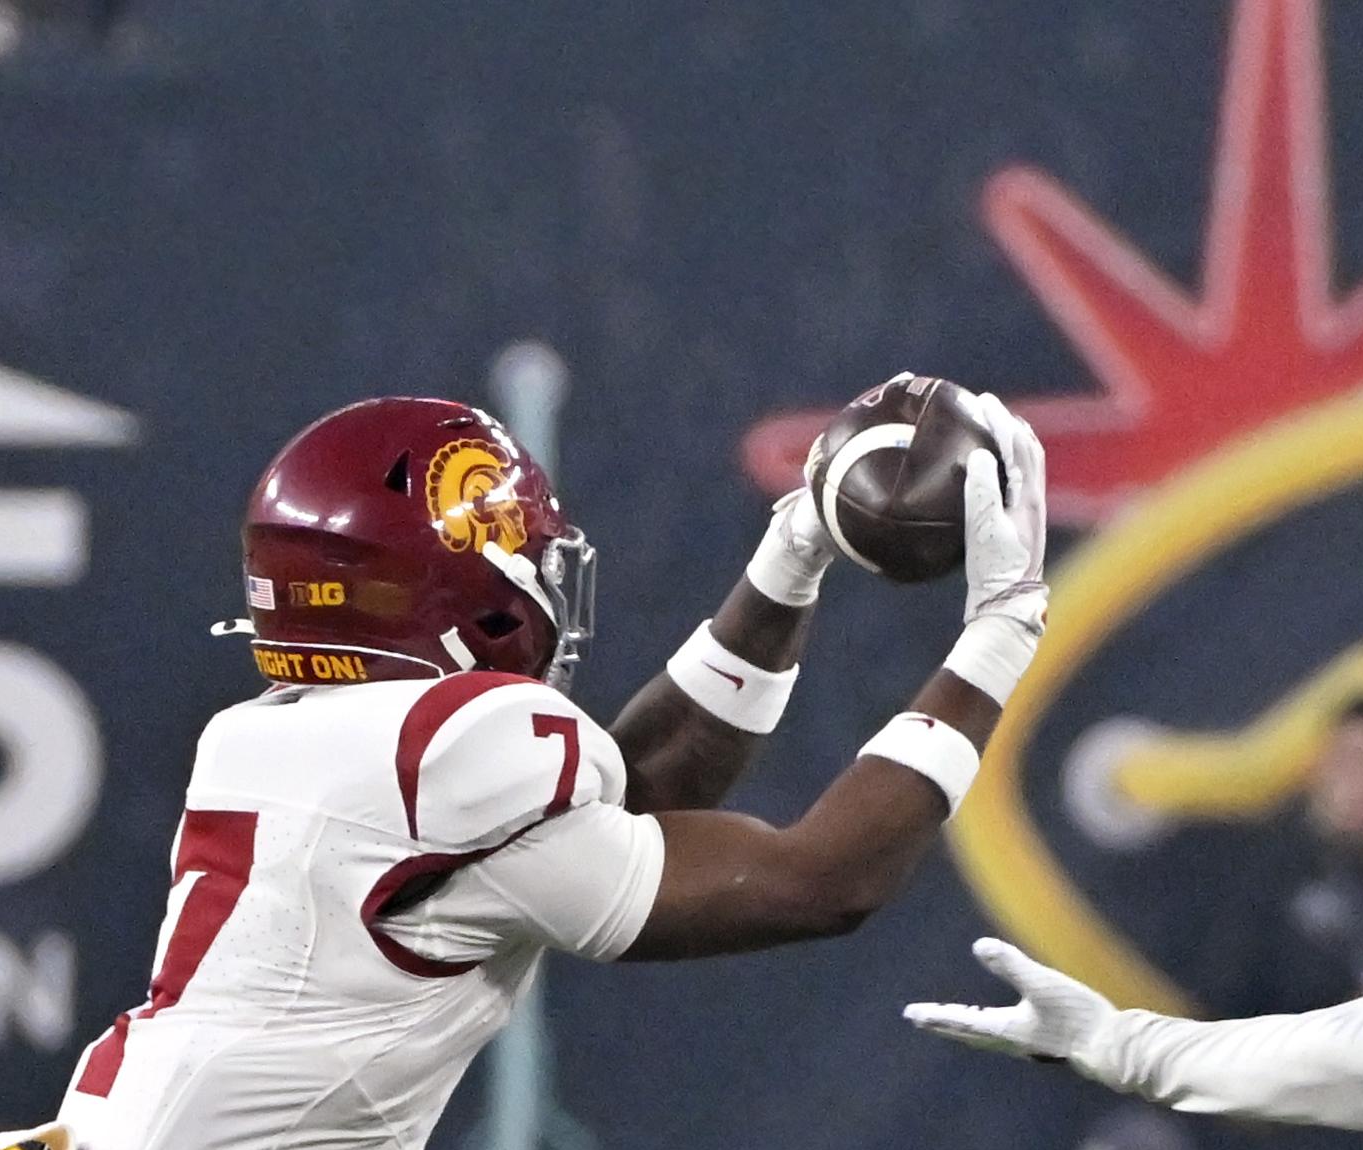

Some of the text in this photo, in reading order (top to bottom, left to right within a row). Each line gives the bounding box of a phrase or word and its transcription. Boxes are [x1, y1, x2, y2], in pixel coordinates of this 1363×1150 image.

[311, 654, 368, 680] ON!
[532, 712, 580, 818] 7
[75, 808, 259, 1100] 7
